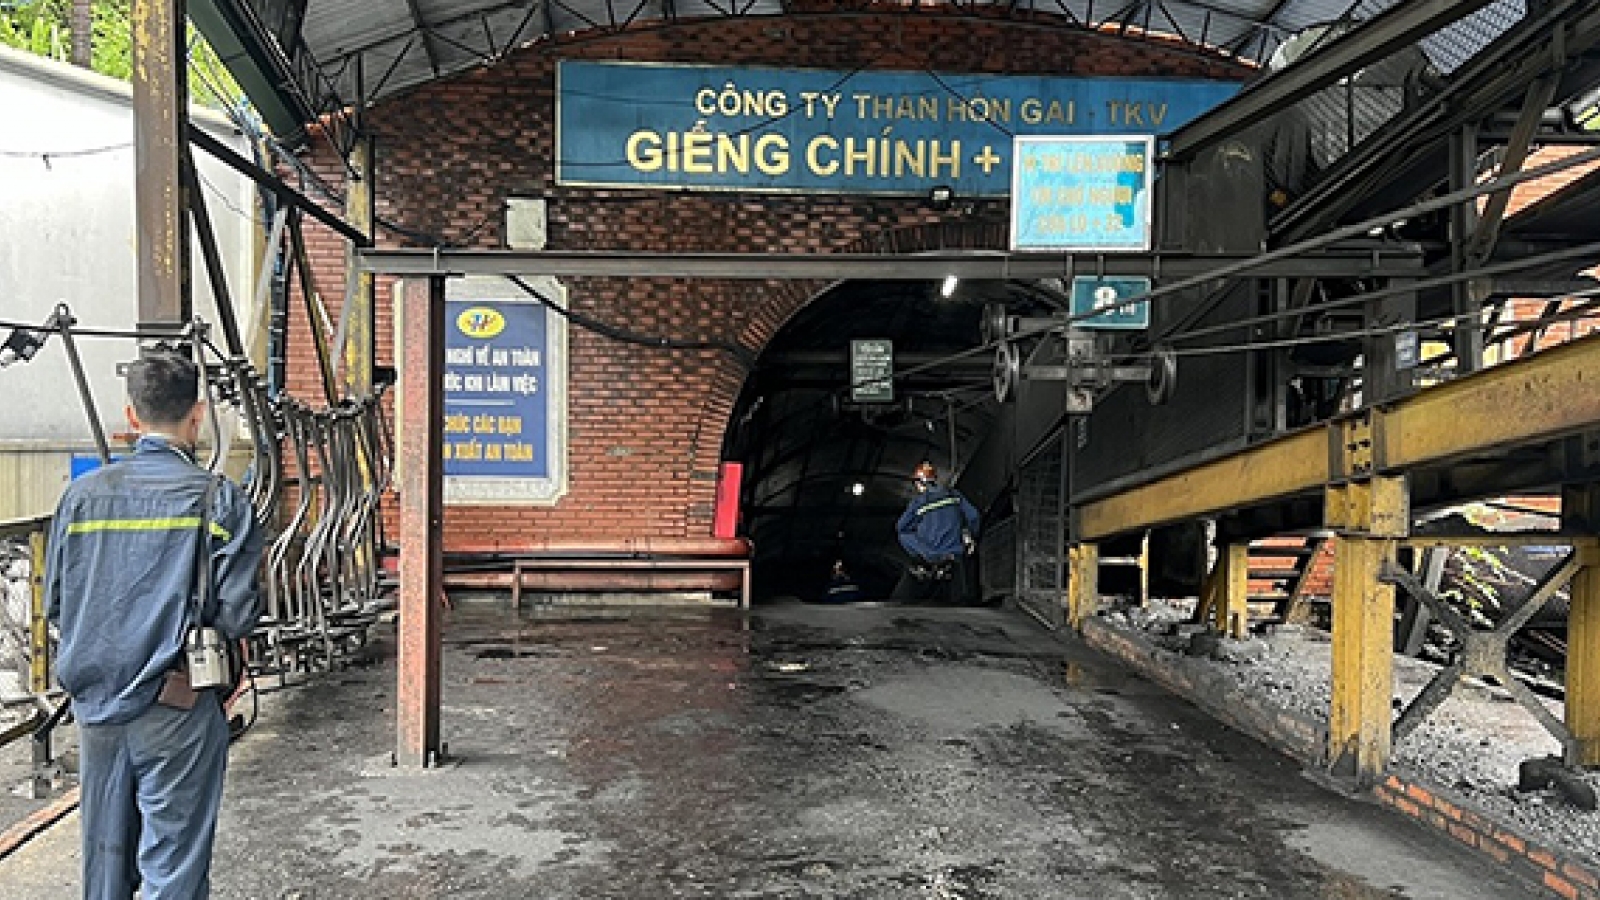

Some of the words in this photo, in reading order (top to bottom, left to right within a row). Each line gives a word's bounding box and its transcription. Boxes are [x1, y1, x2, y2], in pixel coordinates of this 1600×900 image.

[695, 82, 788, 117] CÔNG
[800, 92, 842, 119] TY
[852, 94, 939, 122] THAN
[1020, 98, 1076, 125] GAI
[1107, 100, 1169, 126] TKV
[626, 120, 791, 175] GIẾNG
[806, 125, 962, 179] CHÍNH
